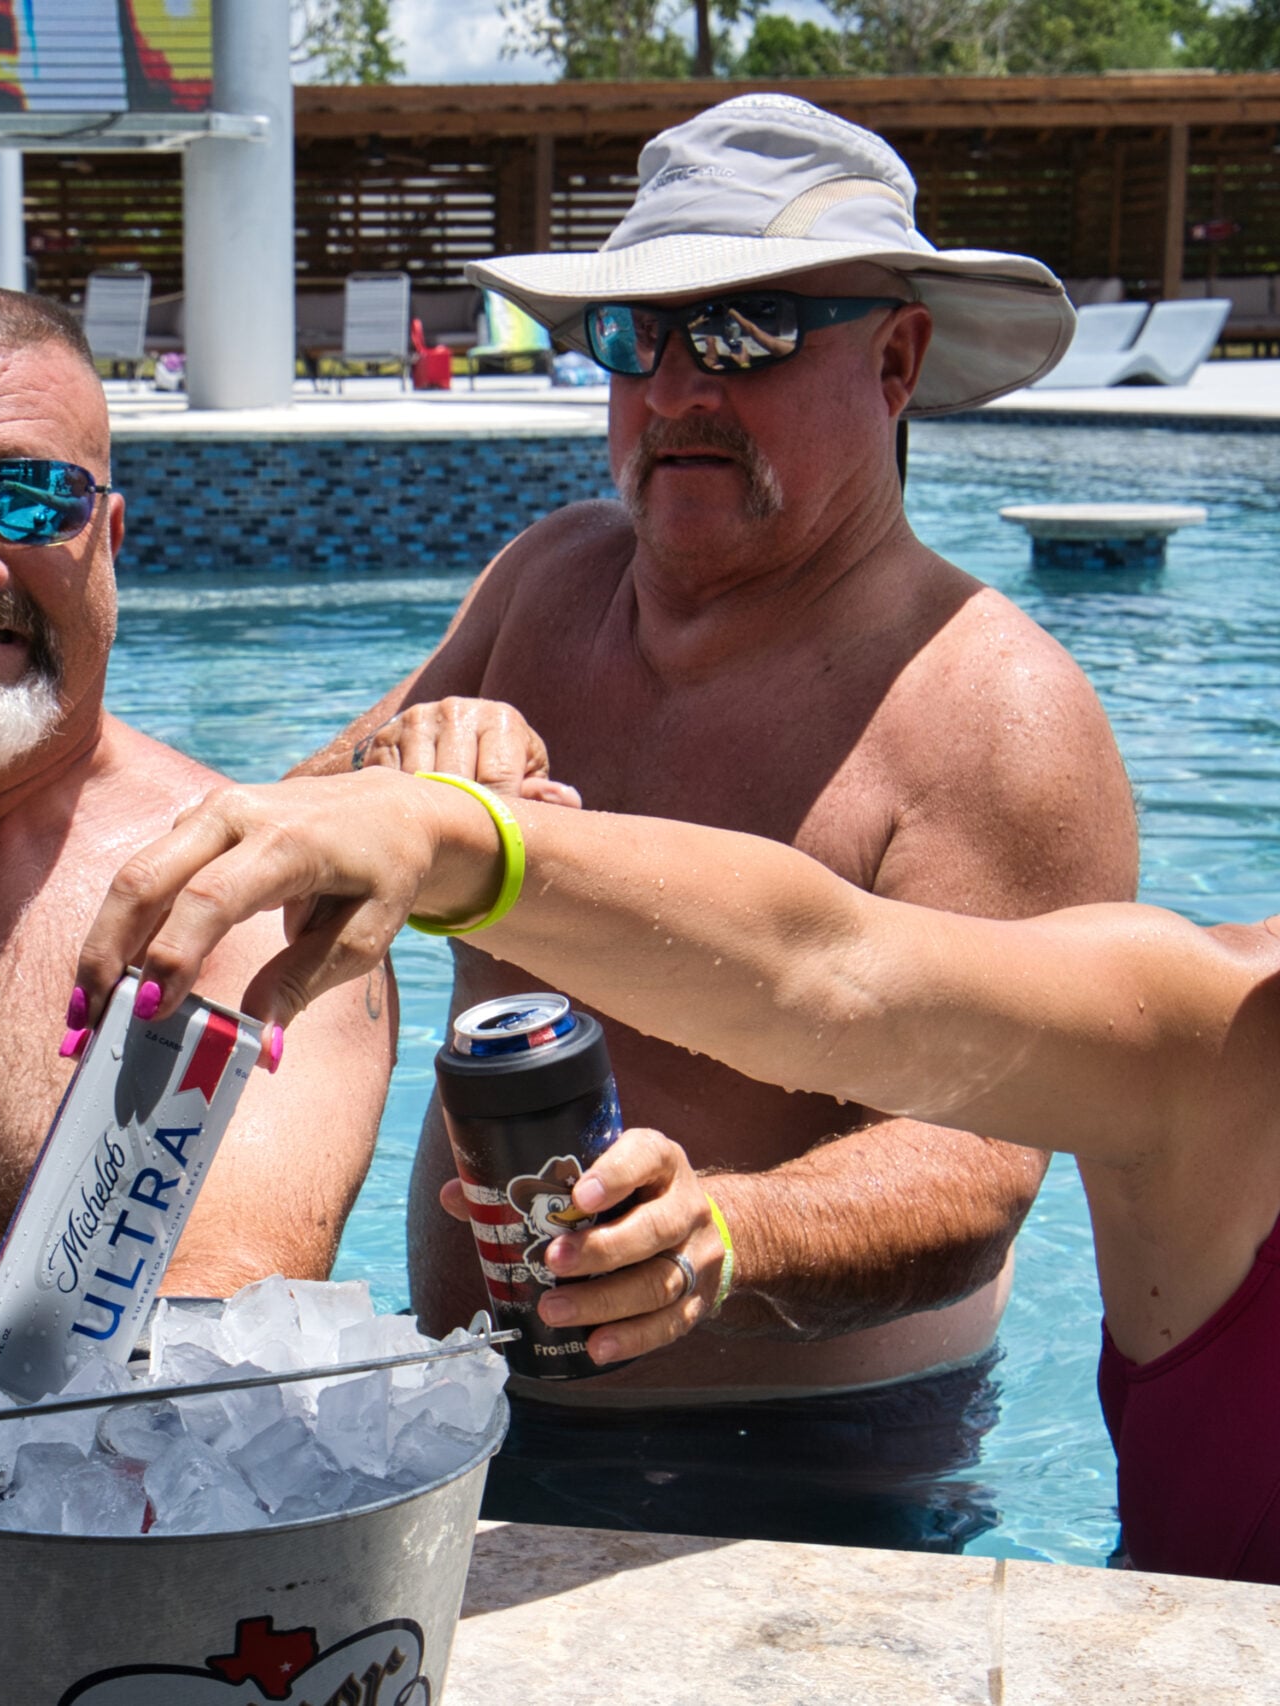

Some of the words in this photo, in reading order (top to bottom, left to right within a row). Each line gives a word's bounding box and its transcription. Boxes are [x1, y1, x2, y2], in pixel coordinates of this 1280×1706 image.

[48, 1131, 126, 1293] Michelob
[71, 1127, 203, 1341] ULTRA
[131, 1251, 166, 1321] SUPERIOR
[533, 1340, 588, 1357] FrostBu
